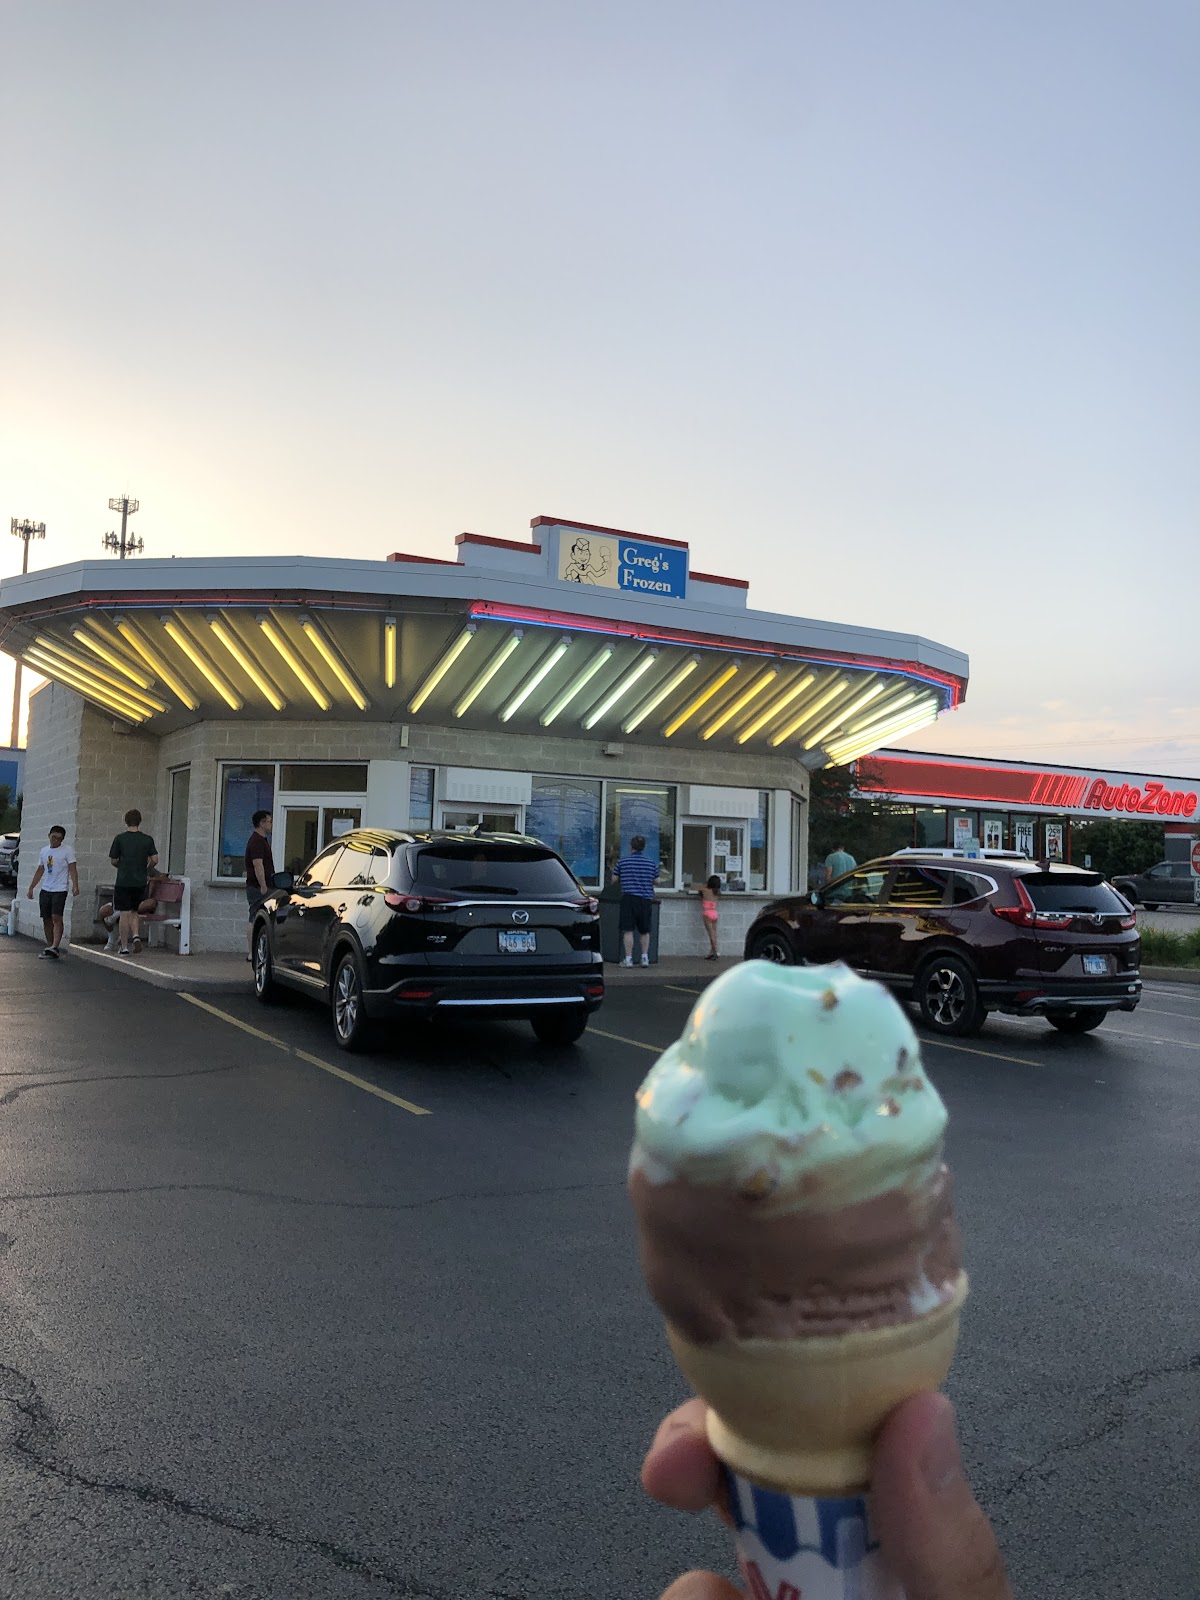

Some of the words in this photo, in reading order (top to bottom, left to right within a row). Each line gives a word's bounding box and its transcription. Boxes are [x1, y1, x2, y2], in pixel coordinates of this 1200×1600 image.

[623, 547, 669, 574] Greg's
[623, 568, 671, 592] Frozen
[1083, 778, 1198, 817] AutoZone
[1017, 826, 1031, 836] FREE
